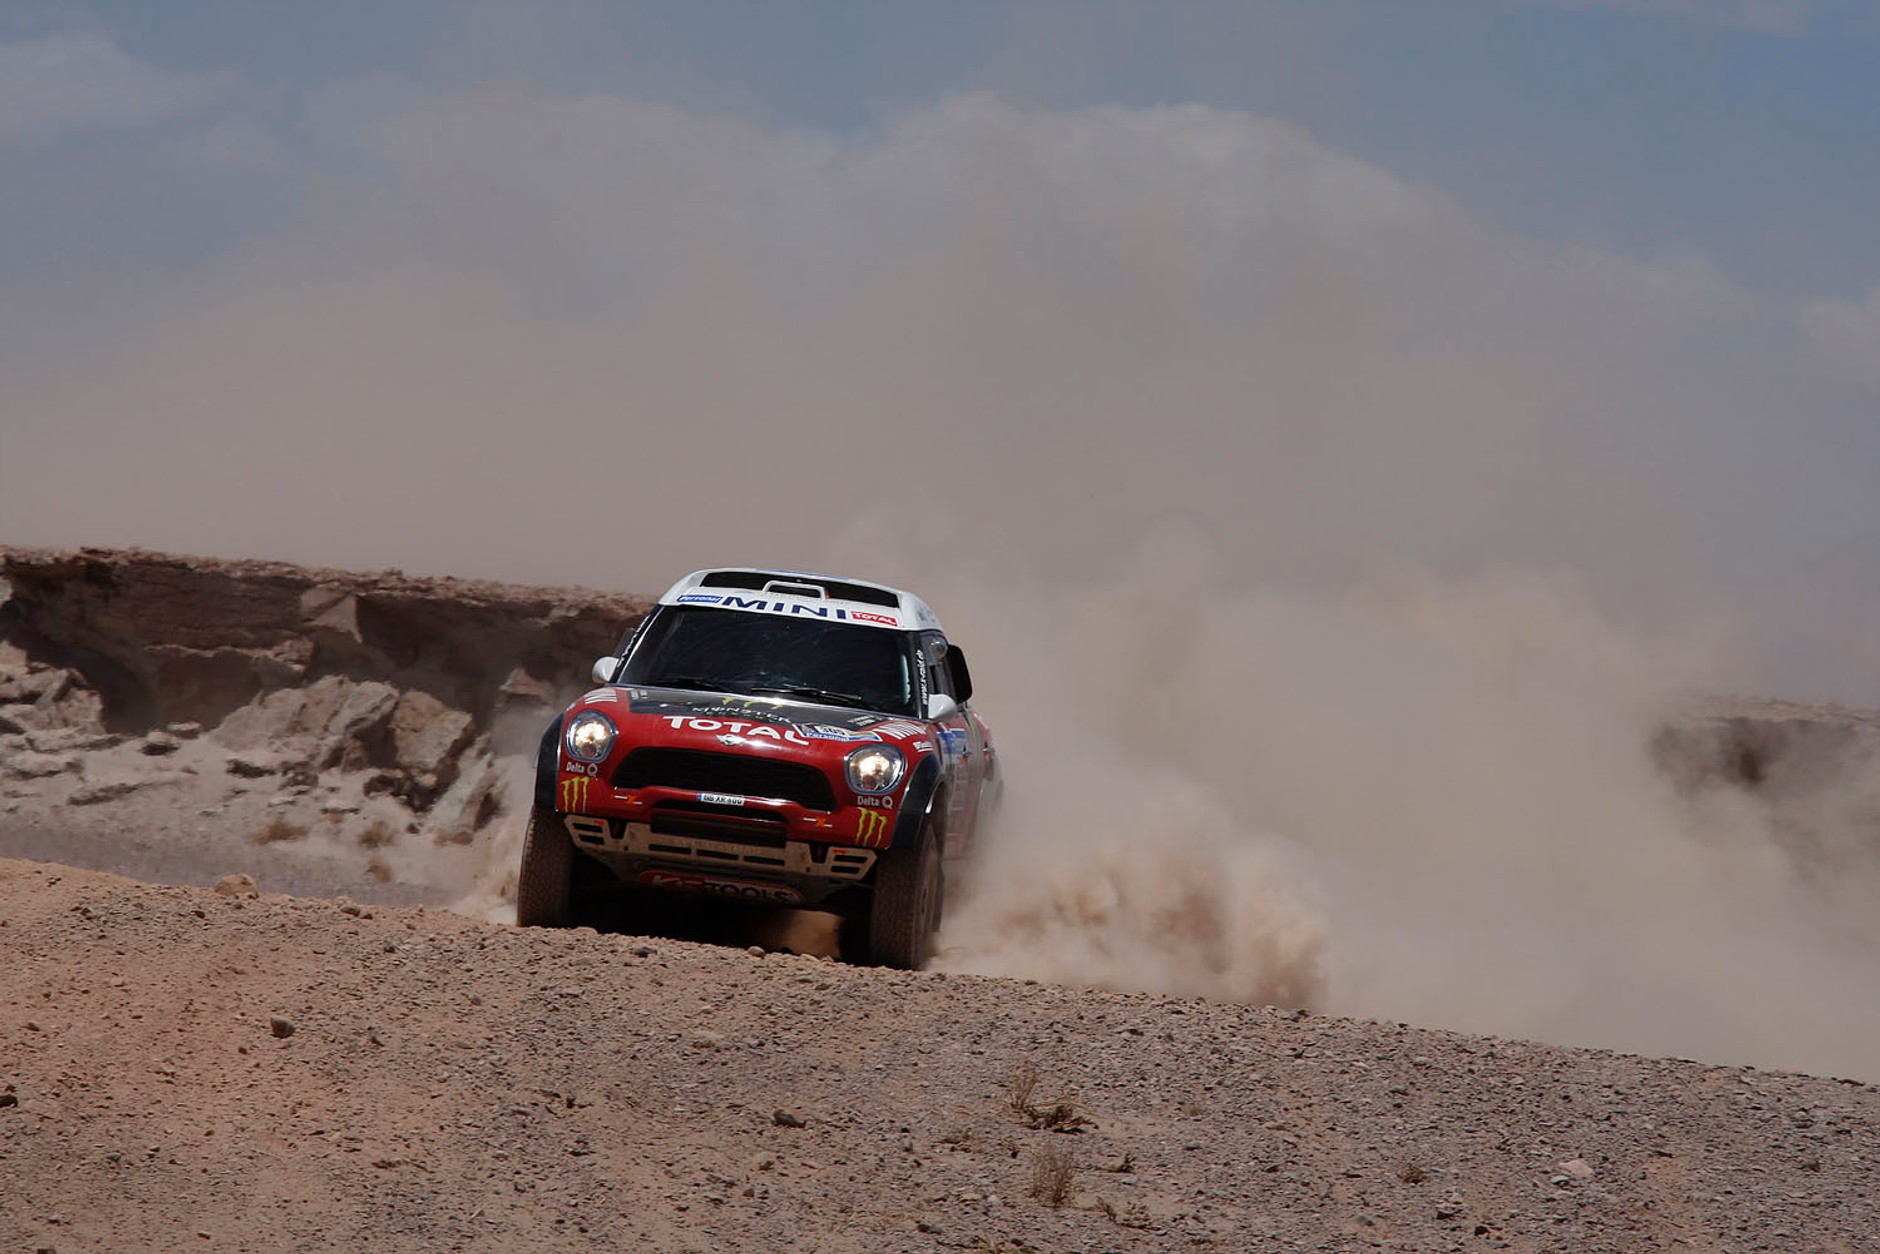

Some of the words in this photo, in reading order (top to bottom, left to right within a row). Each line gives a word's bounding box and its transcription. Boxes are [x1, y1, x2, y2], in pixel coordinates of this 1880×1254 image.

[722, 596, 847, 620] MINI
[853, 611, 898, 626] TOTAL
[662, 715, 810, 746] TOTAL
[566, 761, 585, 773] Delta
[857, 795, 880, 807] Delta
[882, 796, 894, 810] Q
